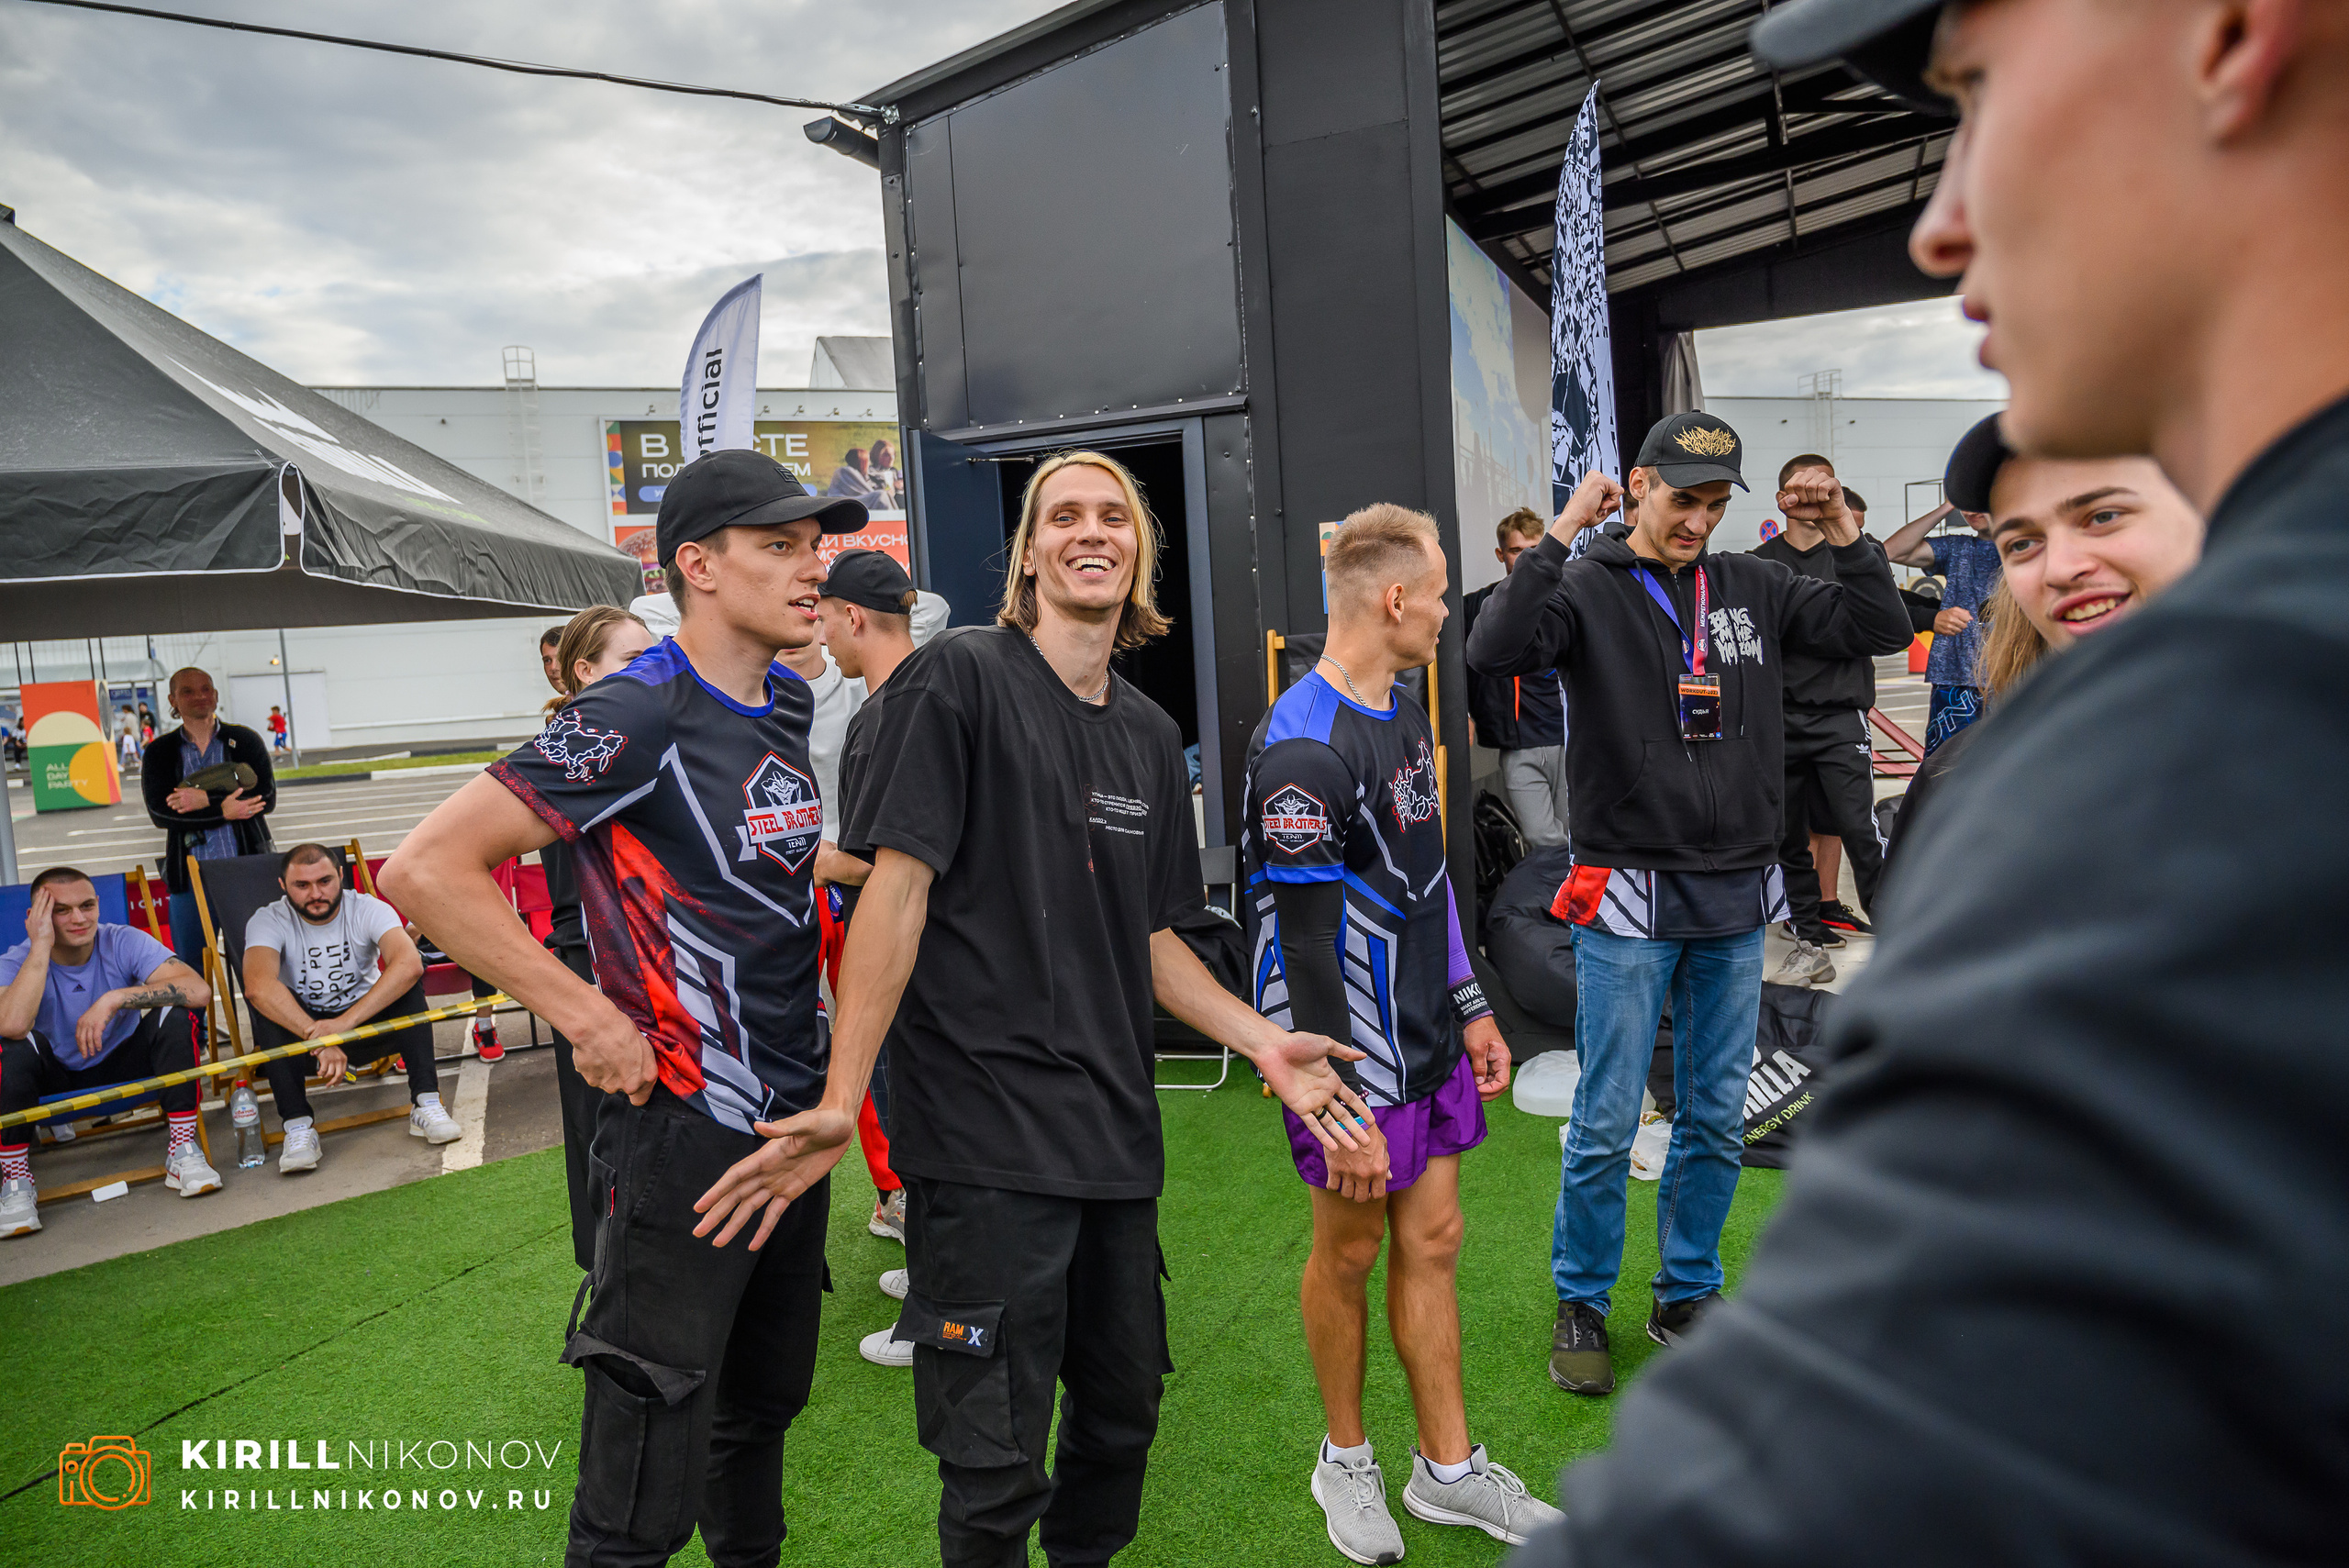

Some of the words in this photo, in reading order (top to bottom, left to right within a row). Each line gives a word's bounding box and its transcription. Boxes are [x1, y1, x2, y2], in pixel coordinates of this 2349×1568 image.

[47, 763, 69, 772] ALL
[47, 772, 69, 781] DAY
[48, 779, 89, 790] PARTY
[748, 813, 784, 836] STEEL
[1283, 818, 1327, 830] BROTHERS
[786, 837, 807, 849] TEAM
[1742, 1115, 1783, 1145] ENERGY
[1780, 1091, 1815, 1120] DRINK
[943, 1321, 964, 1336] RAM
[968, 1327, 984, 1347] X
